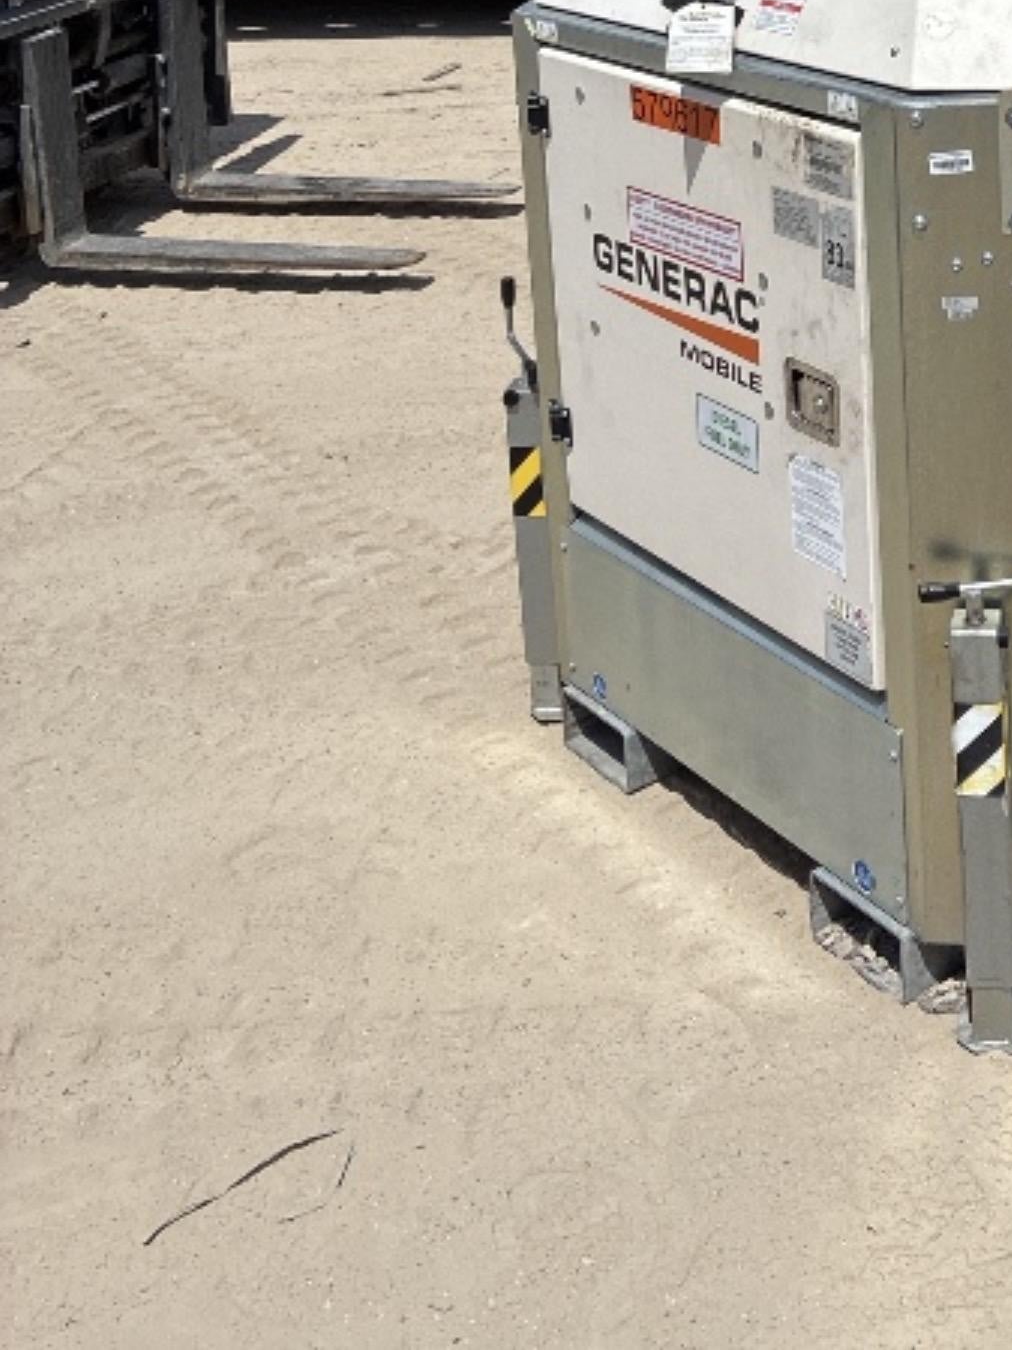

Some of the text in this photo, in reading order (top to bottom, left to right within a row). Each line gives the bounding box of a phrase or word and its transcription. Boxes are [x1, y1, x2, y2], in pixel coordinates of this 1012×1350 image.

[633, 87, 719, 141] 579617
[593, 233, 760, 333] GENERAC
[680, 339, 763, 394] MOBILE
